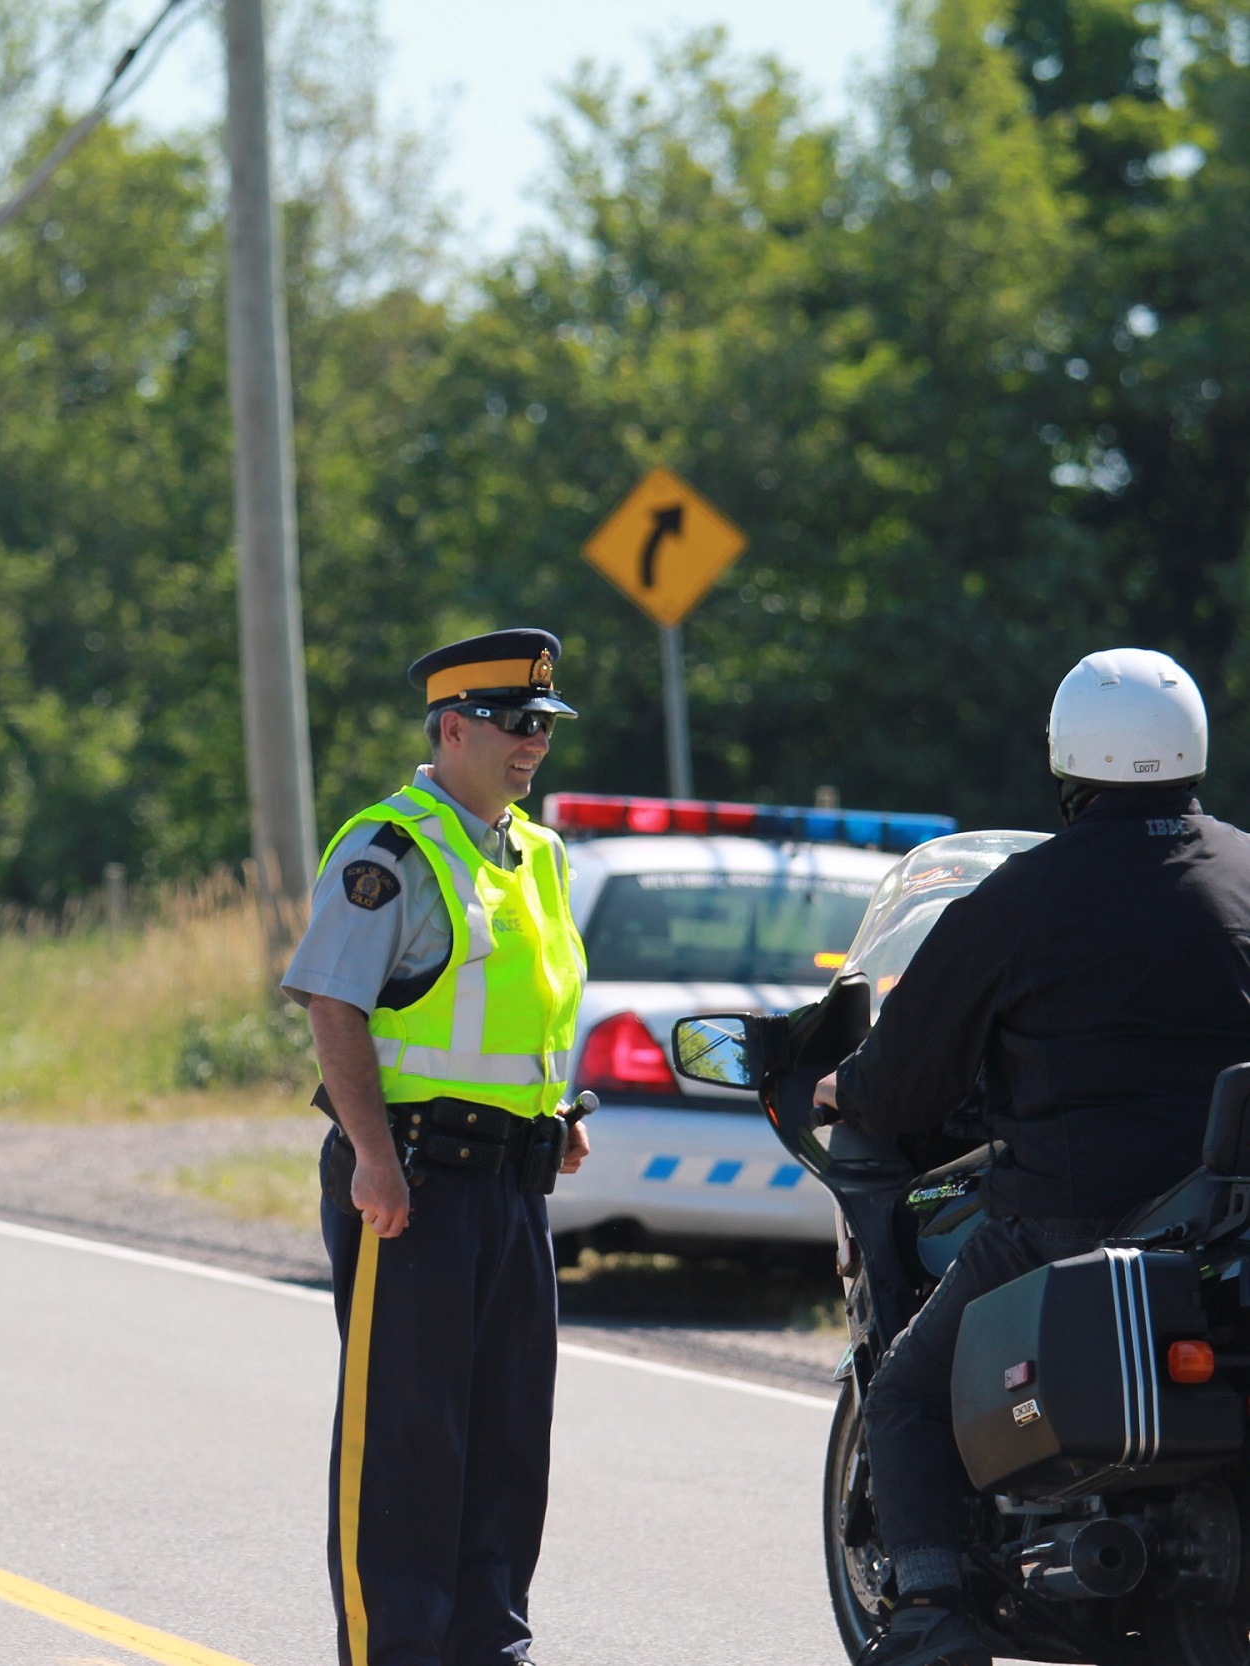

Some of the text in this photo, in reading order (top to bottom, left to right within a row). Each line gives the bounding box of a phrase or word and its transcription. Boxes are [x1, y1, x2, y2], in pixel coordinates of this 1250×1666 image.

[1139, 764, 1155, 773] DOT
[1145, 819, 1190, 836] IBM
[351, 892, 375, 908] POLICE
